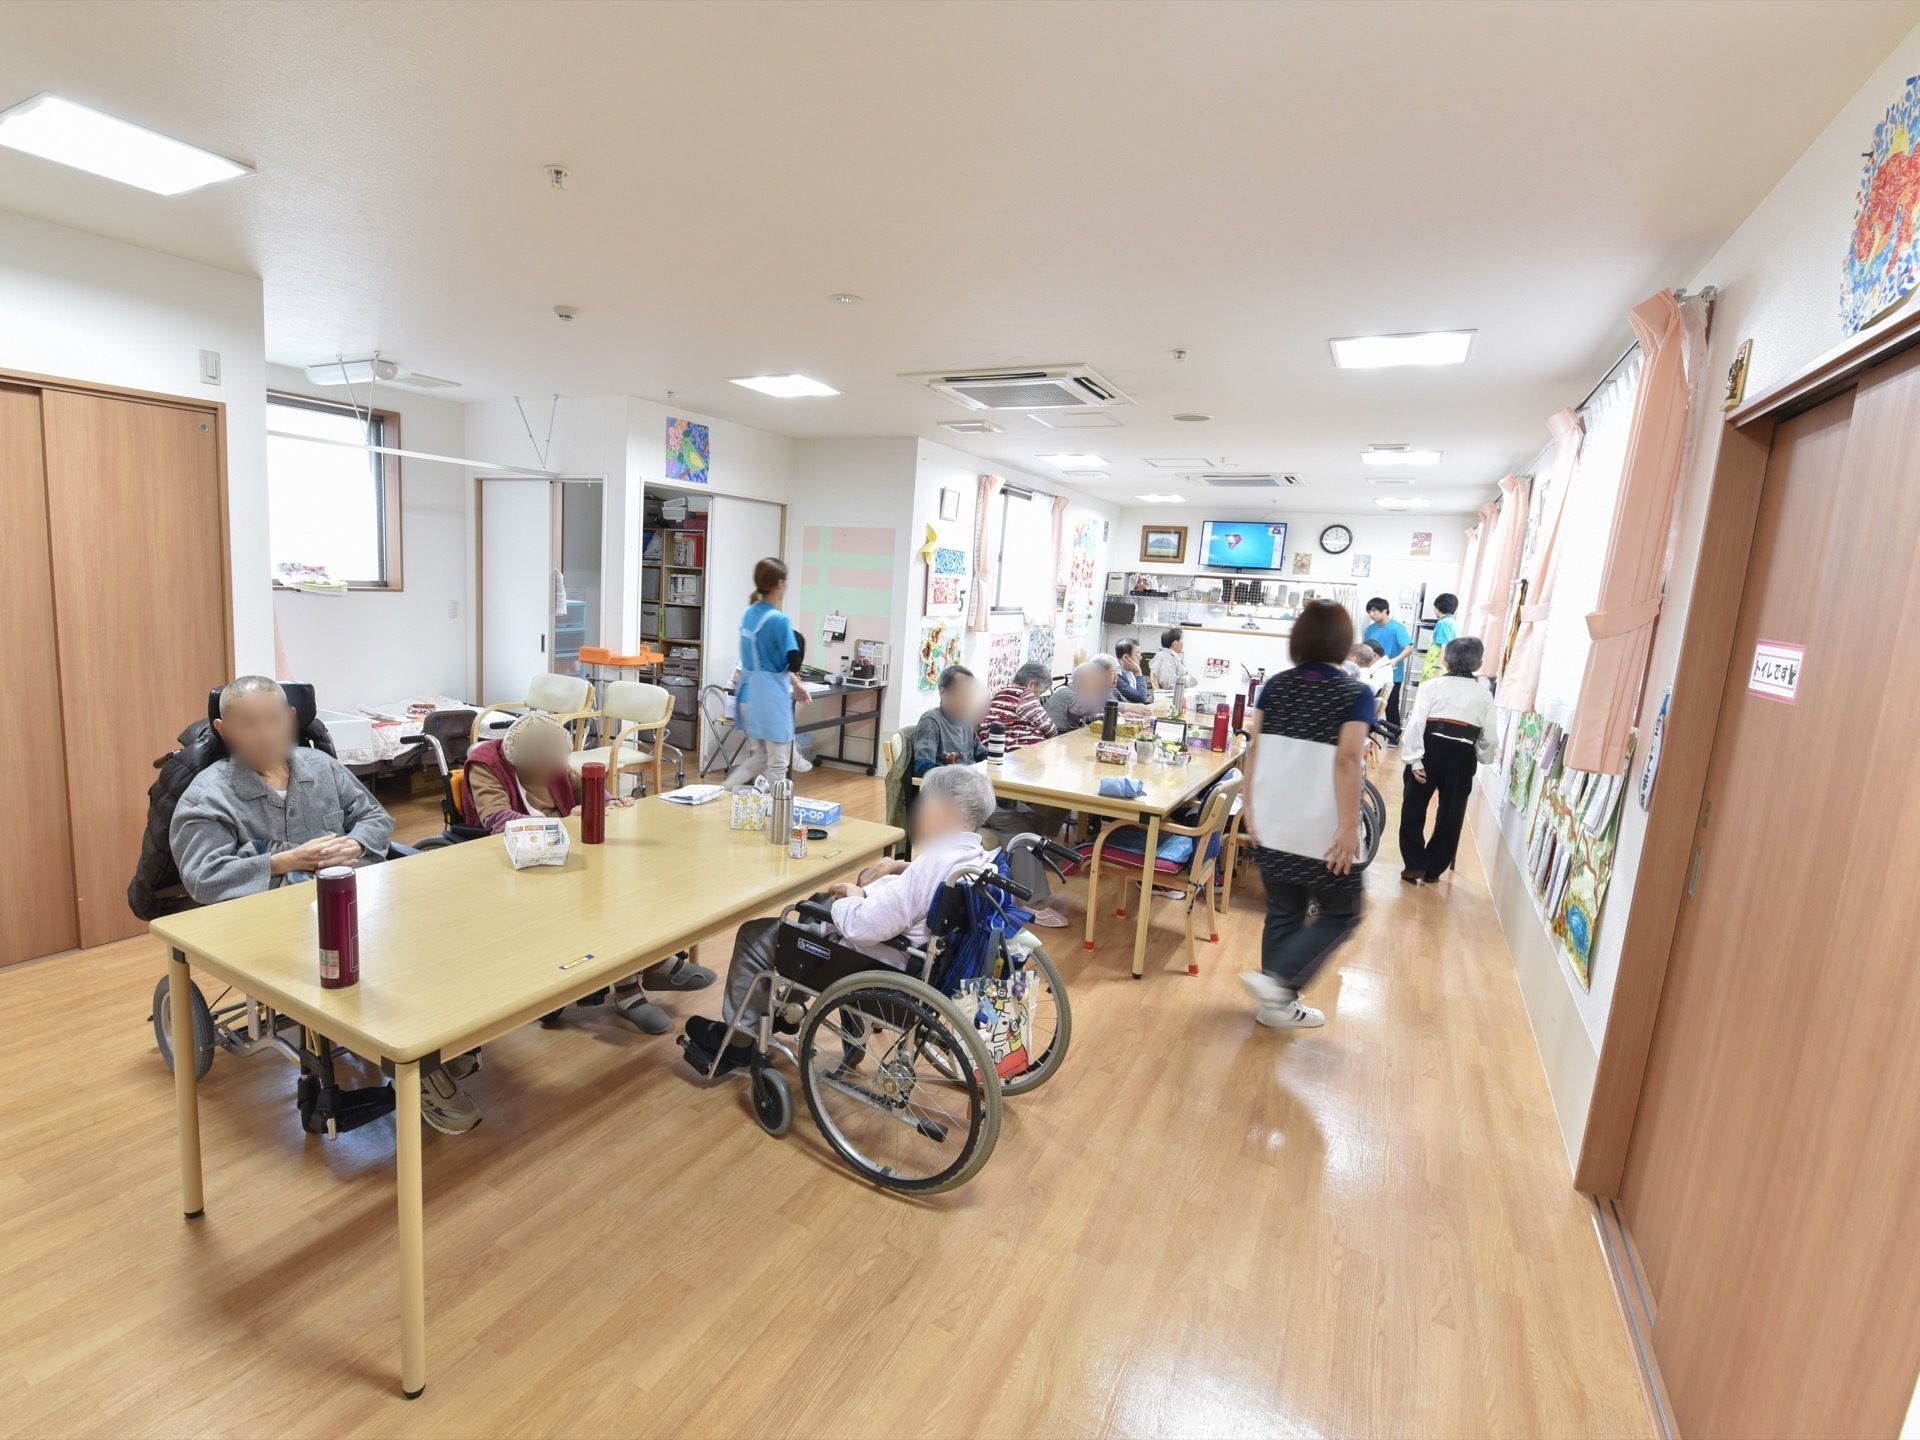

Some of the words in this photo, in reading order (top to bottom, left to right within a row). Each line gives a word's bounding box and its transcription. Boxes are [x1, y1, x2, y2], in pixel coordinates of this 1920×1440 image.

[1754, 660, 1789, 682] トイレです
